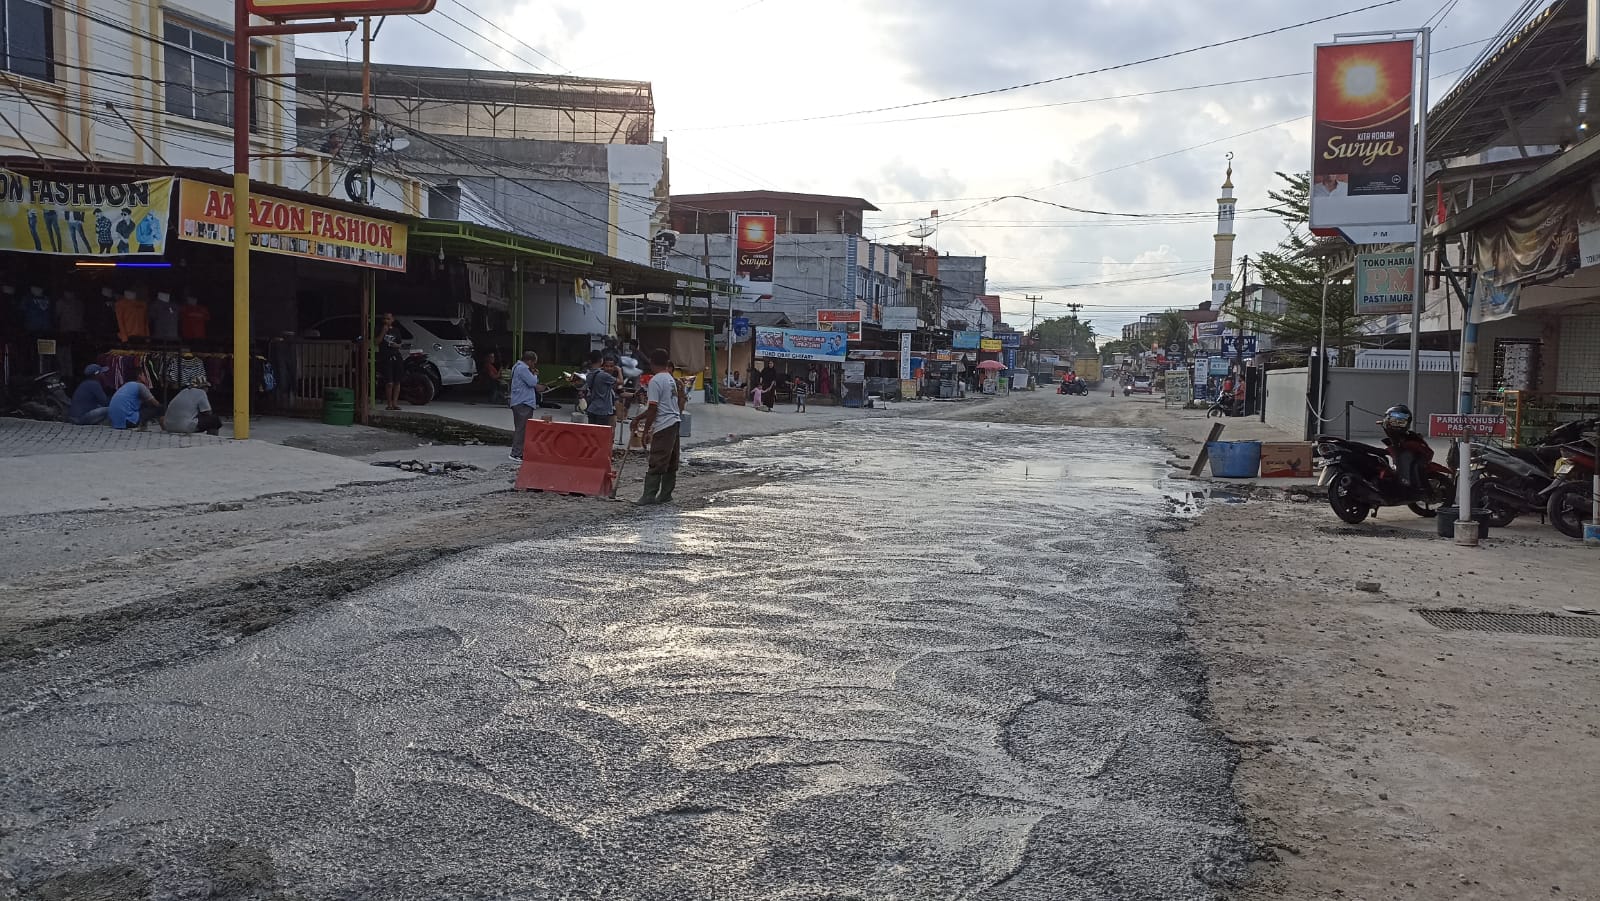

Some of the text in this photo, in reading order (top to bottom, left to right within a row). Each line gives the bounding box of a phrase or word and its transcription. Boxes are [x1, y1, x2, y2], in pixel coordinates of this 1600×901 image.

[1357, 131, 1395, 141] KITA ADALAH
[1323, 135, 1404, 166] Surya
[29, 178, 149, 207] FASHION
[311, 210, 393, 249] FASHION
[740, 255, 771, 269] Surya
[1363, 259, 1386, 267] TOKO
[1365, 267, 1414, 293] PM
[1363, 294, 1413, 304] PASTI MURA
[1436, 416, 1467, 424] PARKIR
[1479, 424, 1493, 432] Drg
